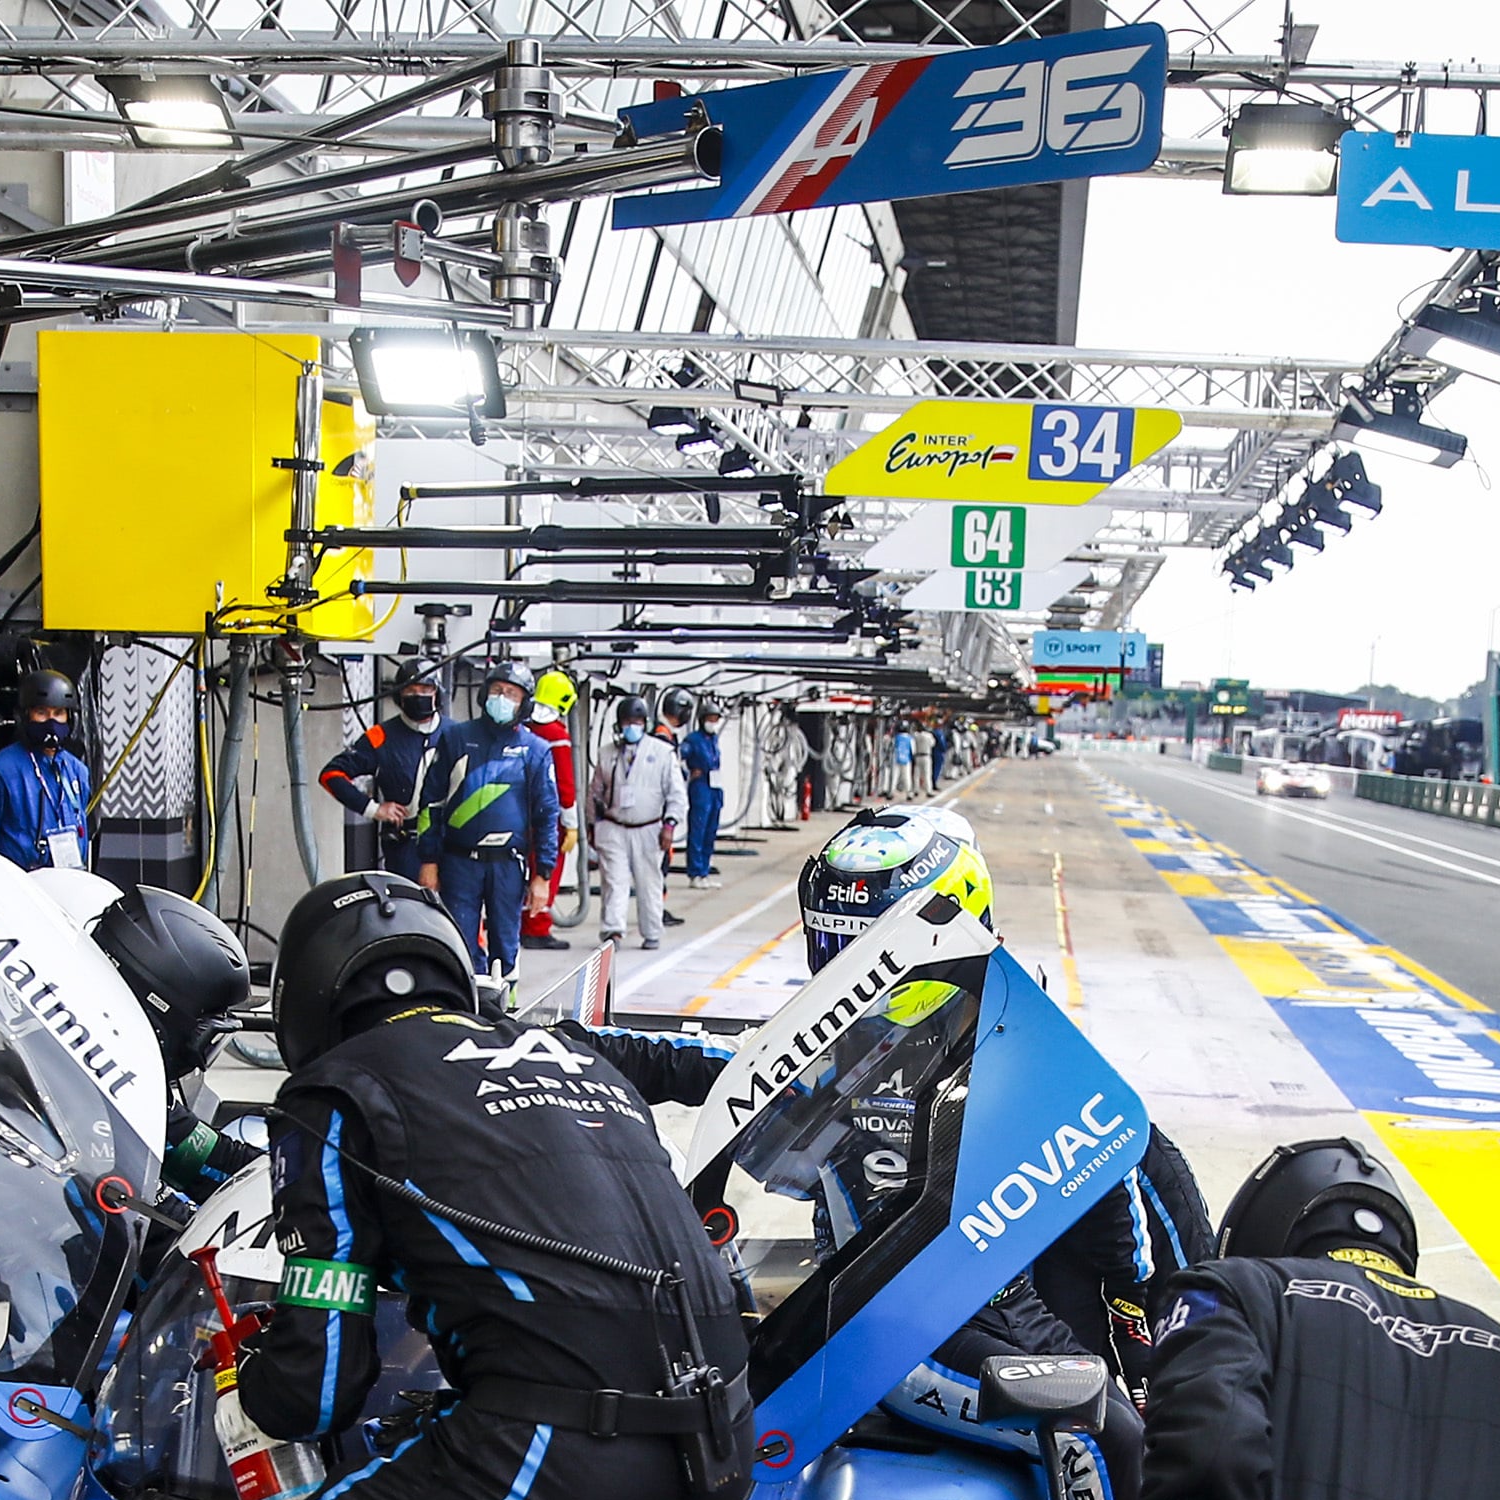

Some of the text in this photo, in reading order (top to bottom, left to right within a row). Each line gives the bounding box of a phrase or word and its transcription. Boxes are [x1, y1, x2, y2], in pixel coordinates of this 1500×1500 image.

[944, 44, 1154, 170] 36
[885, 432, 996, 478] Europol
[923, 434, 968, 447] INTER
[1037, 409, 1123, 478] 34
[962, 509, 1013, 564] 64
[974, 571, 1013, 607] 63
[1066, 643, 1102, 654] SPORT
[899, 840, 951, 890] NOVAC
[725, 948, 907, 1129] Matmut
[476, 1075, 632, 1106] ALPINE
[484, 1092, 647, 1125] ENDURANCE TEAM
[958, 1091, 1125, 1254] NOVAC
[1059, 1126, 1138, 1199] CONSTRUTORA
[999, 1360, 1056, 1382] elf
